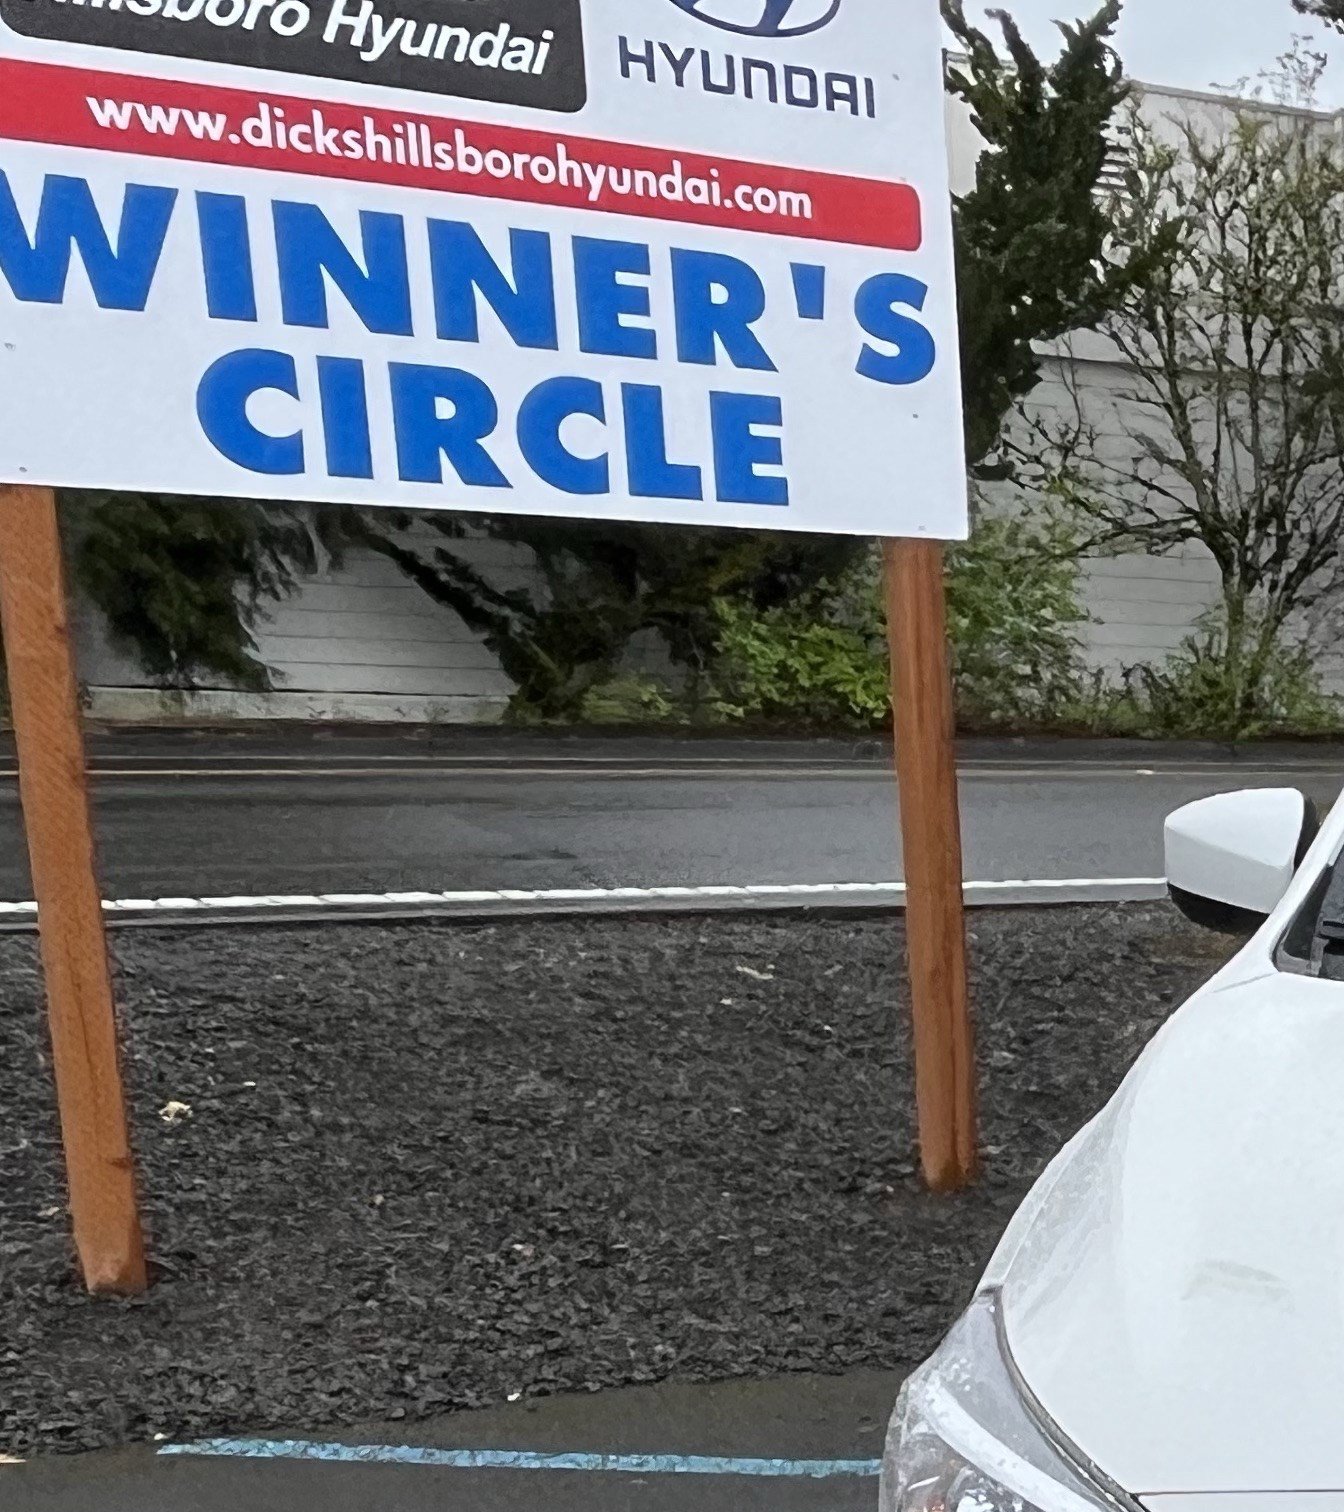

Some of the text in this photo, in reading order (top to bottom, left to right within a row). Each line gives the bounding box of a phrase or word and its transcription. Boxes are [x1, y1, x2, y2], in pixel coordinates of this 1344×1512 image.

[323, 0, 554, 76] Hyundai
[618, 35, 876, 119] HYUNDAI
[86, 94, 813, 219] www.dickshillsborohyundai.com
[0, 170, 937, 385] WINNER'S
[195, 347, 790, 506] CIRCLE
